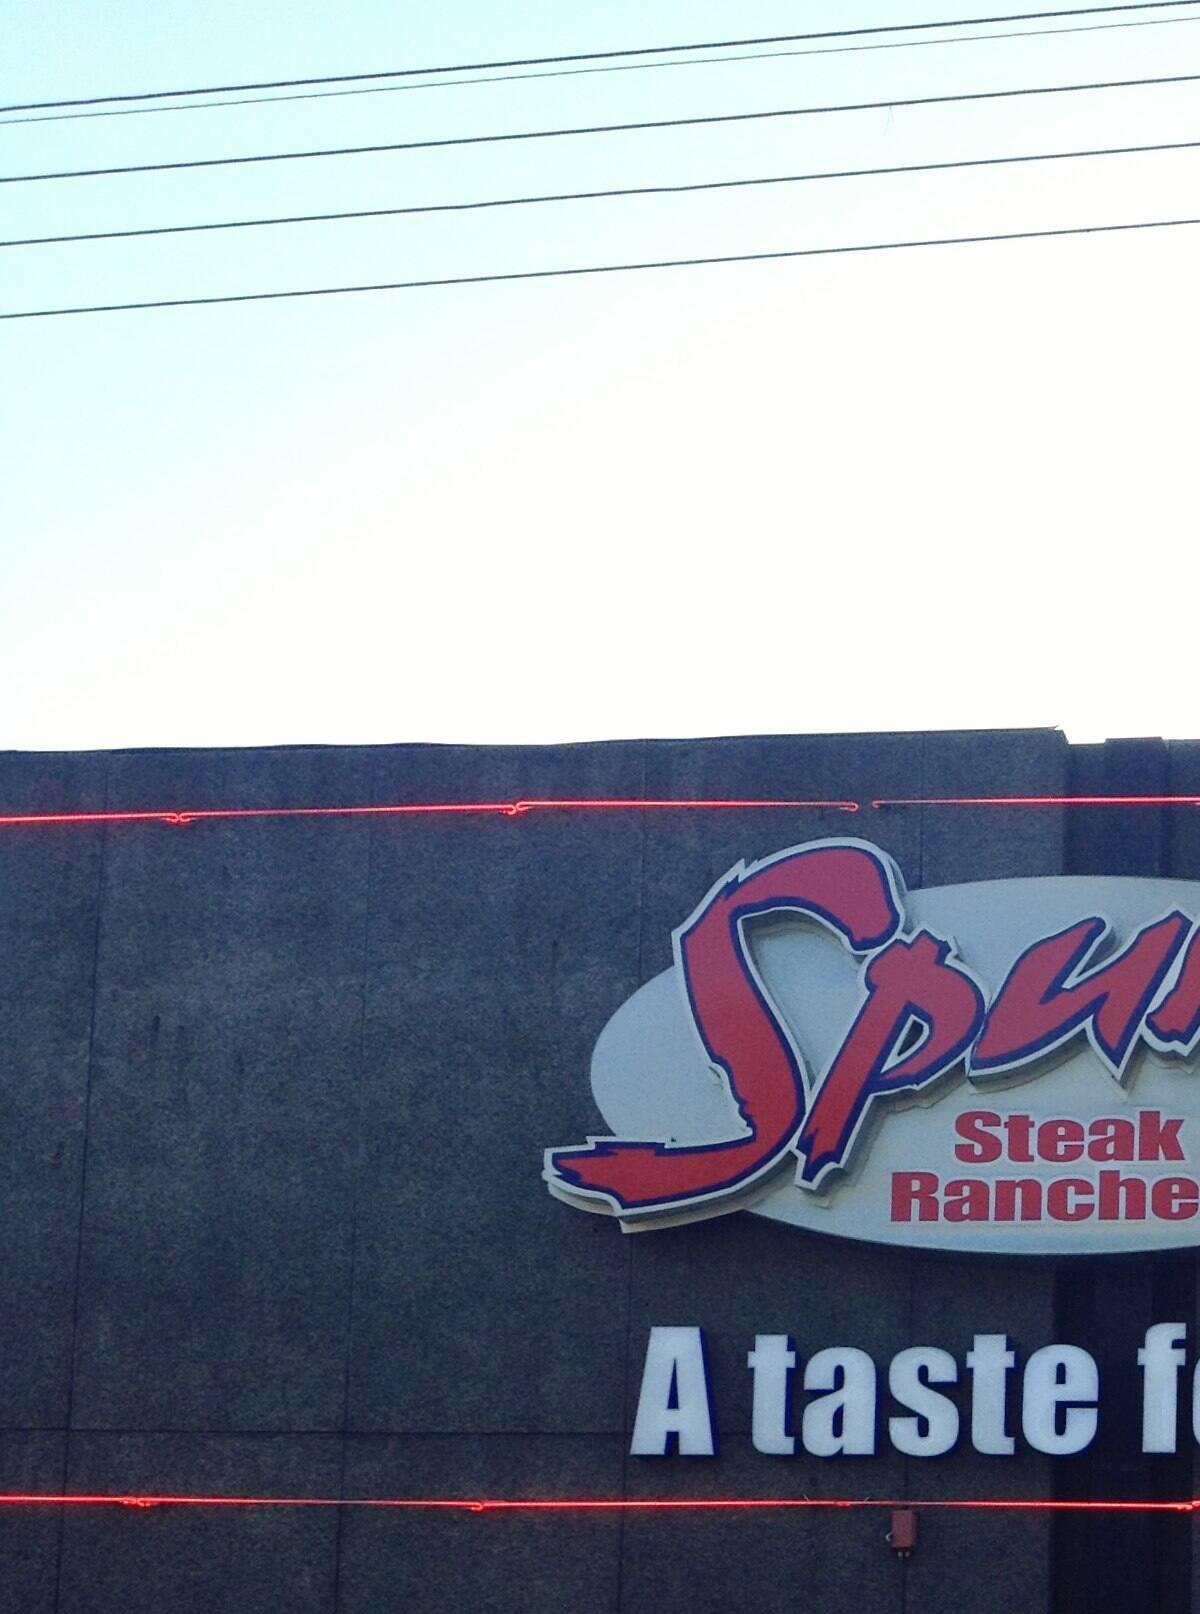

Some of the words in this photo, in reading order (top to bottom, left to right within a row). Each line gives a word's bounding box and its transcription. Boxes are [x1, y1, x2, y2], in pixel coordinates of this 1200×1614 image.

[954, 1108, 1186, 1165] Steak
[629, 1325, 714, 1457] A
[745, 1332, 1101, 1457] taste
